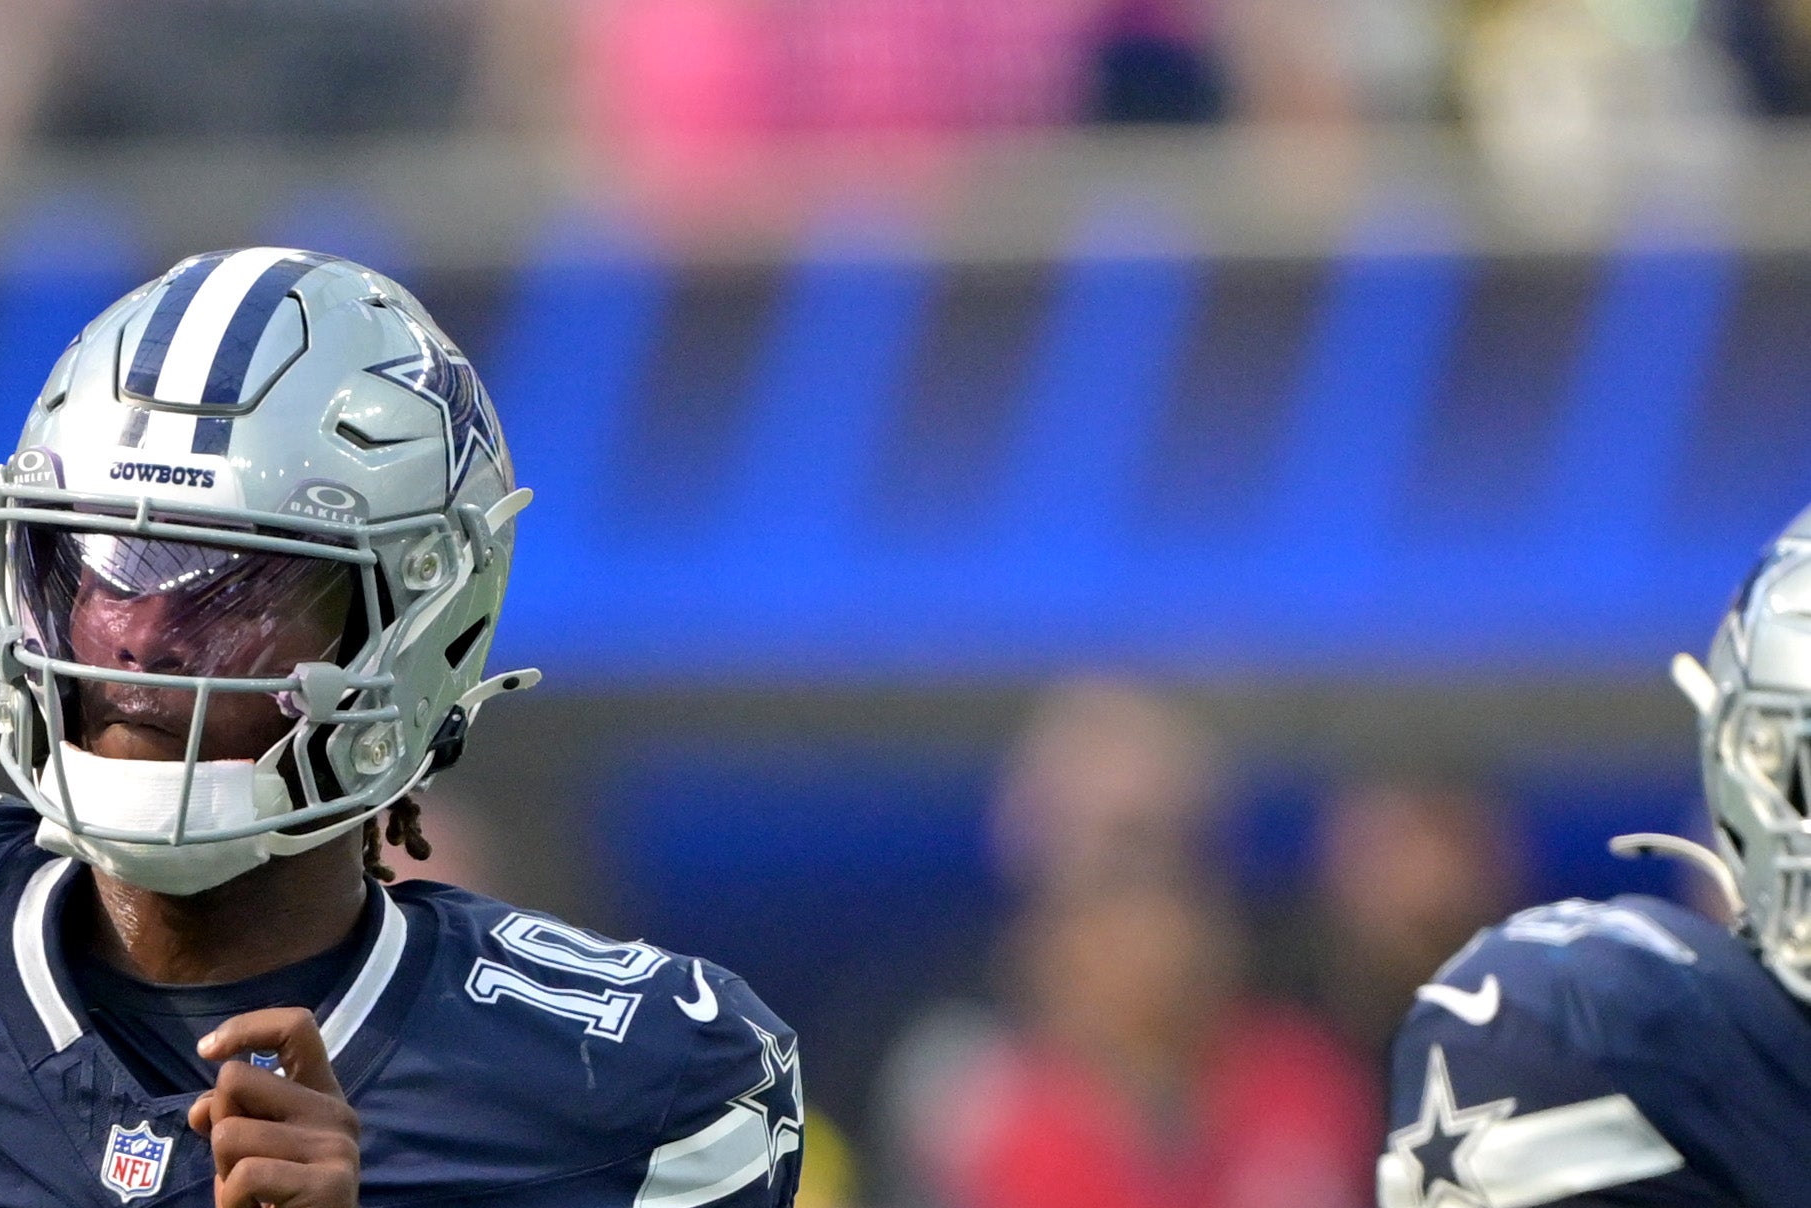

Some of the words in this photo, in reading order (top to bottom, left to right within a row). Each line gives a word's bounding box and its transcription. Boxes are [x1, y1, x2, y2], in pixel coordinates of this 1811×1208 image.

[109, 461, 217, 489] COWBOYS
[290, 501, 365, 526] OAKLEY
[464, 912, 672, 1043] 10
[112, 1155, 154, 1188] NFL
